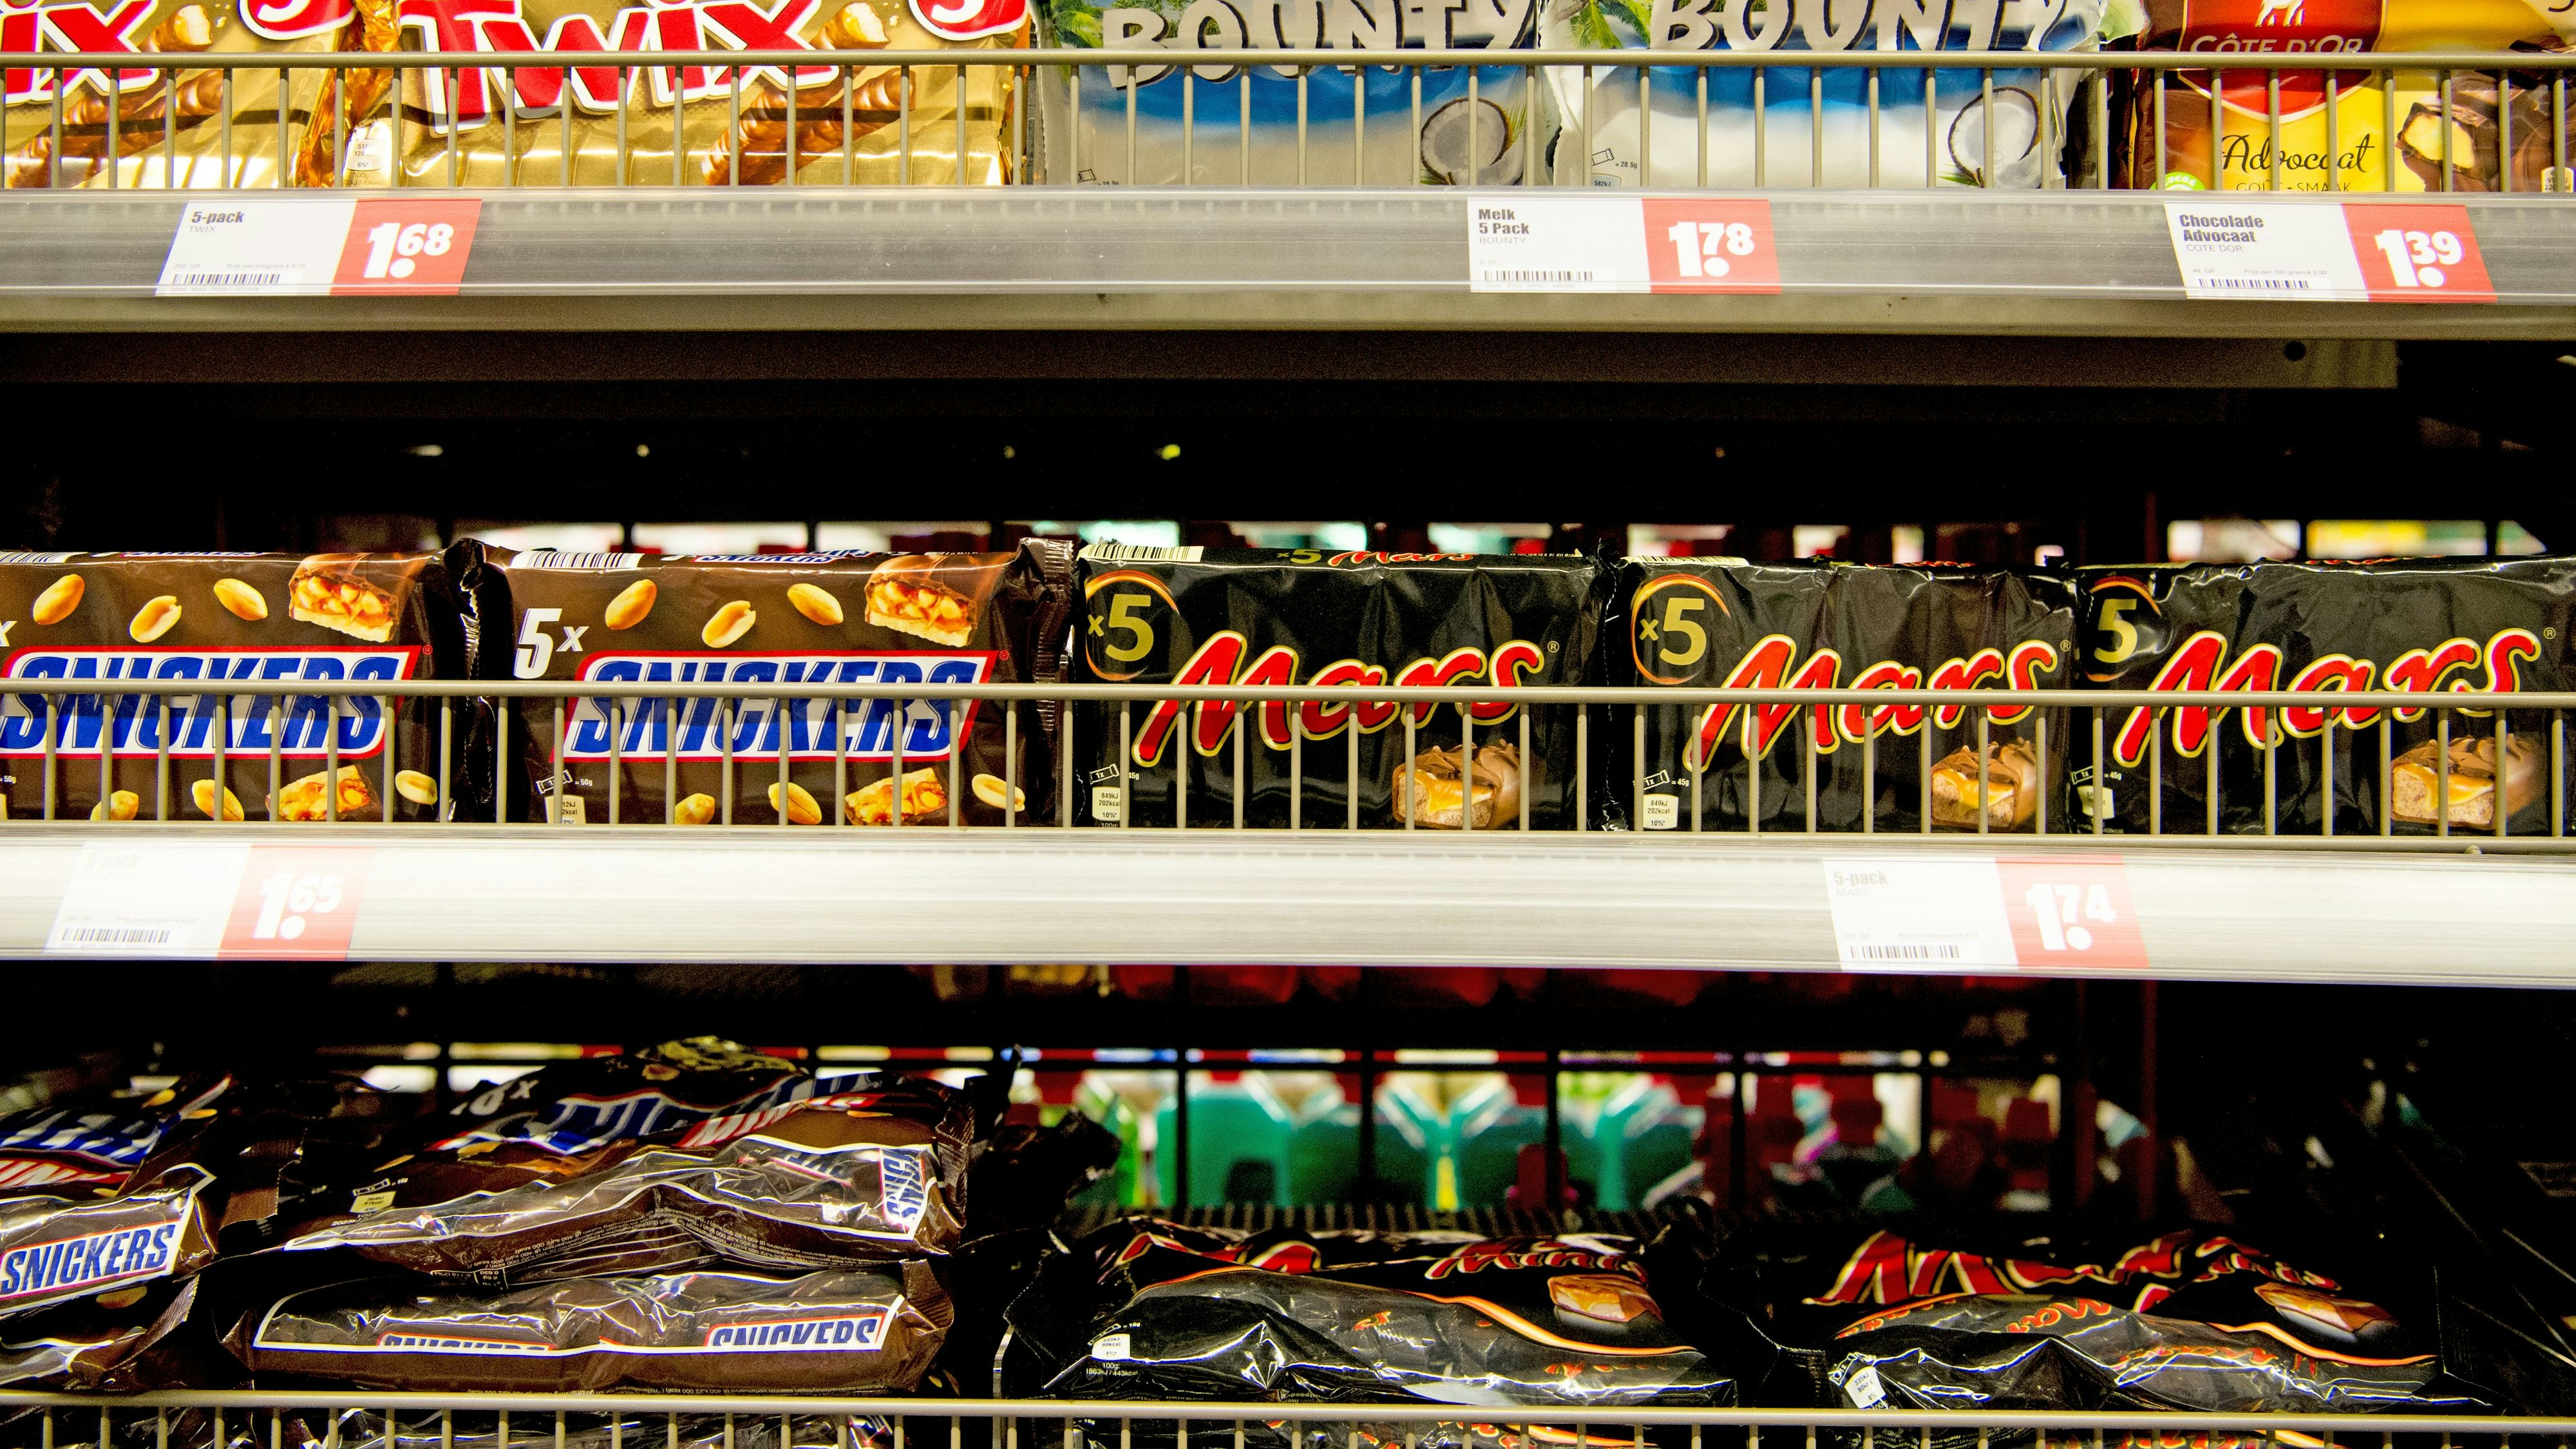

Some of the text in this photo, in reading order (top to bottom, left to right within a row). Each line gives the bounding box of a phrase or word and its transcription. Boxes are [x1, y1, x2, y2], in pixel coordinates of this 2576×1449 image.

[2297, 182, 2351, 191] SMAK
[192, 211, 244, 223] 5-pack
[1479, 209, 1515, 220] Melk
[2179, 214, 2264, 228] Chocolade
[1479, 223, 1530, 234] 5 Pack
[2184, 229, 2257, 242] Advocaat
[364, 222, 453, 278] 1.68
[1669, 222, 1755, 278] 1.78
[2376, 229, 2462, 287] 1.39
[1327, 551, 1475, 566] Mars
[1087, 594, 1155, 663] x5
[1640, 598, 1707, 666] x5
[1, 657, 401, 749] SNICKERS
[1132, 630, 1544, 768] Mars
[1681, 634, 2057, 772] Mars
[2113, 628, 2541, 767] Mars
[571, 660, 976, 753] SNICKERS
[4, 775, 16, 784] 50g
[580, 779, 592, 787] 50g
[1677, 779, 1689, 787] 45g
[86, 853, 139, 869] 5-pack
[1834, 871, 1888, 886] 5-pack
[1836, 888, 1870, 896] MARS
[2, 1224, 176, 1294] SNICKERS
